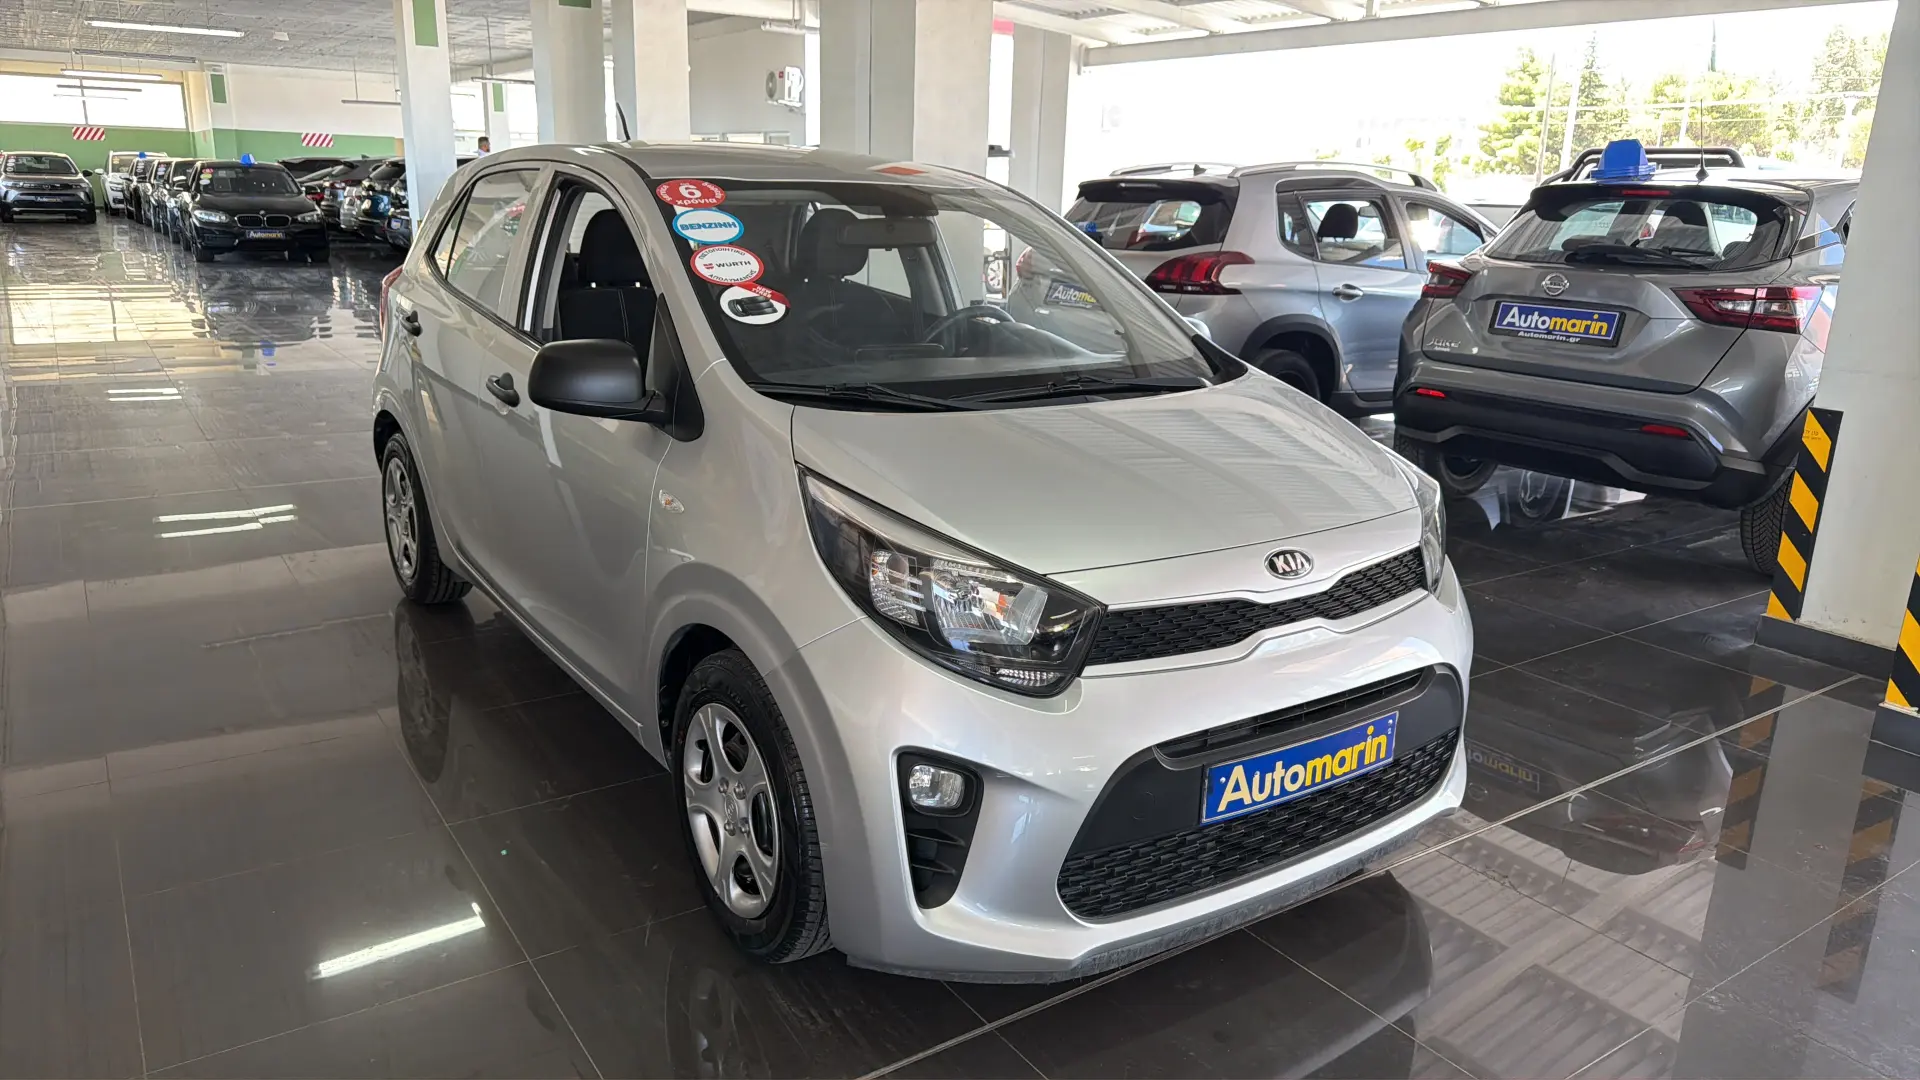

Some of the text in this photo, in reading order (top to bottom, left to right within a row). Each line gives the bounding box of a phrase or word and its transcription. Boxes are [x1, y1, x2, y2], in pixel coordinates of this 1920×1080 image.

[679, 184, 701, 198] 6
[676, 198, 717, 206] χρόνια
[1052, 285, 1097, 303] Automa
[1502, 306, 1608, 336] Automarin
[1518, 331, 1580, 343] Automarin.gr
[1271, 552, 1310, 574] KIA
[1217, 725, 1387, 812] Automarin
